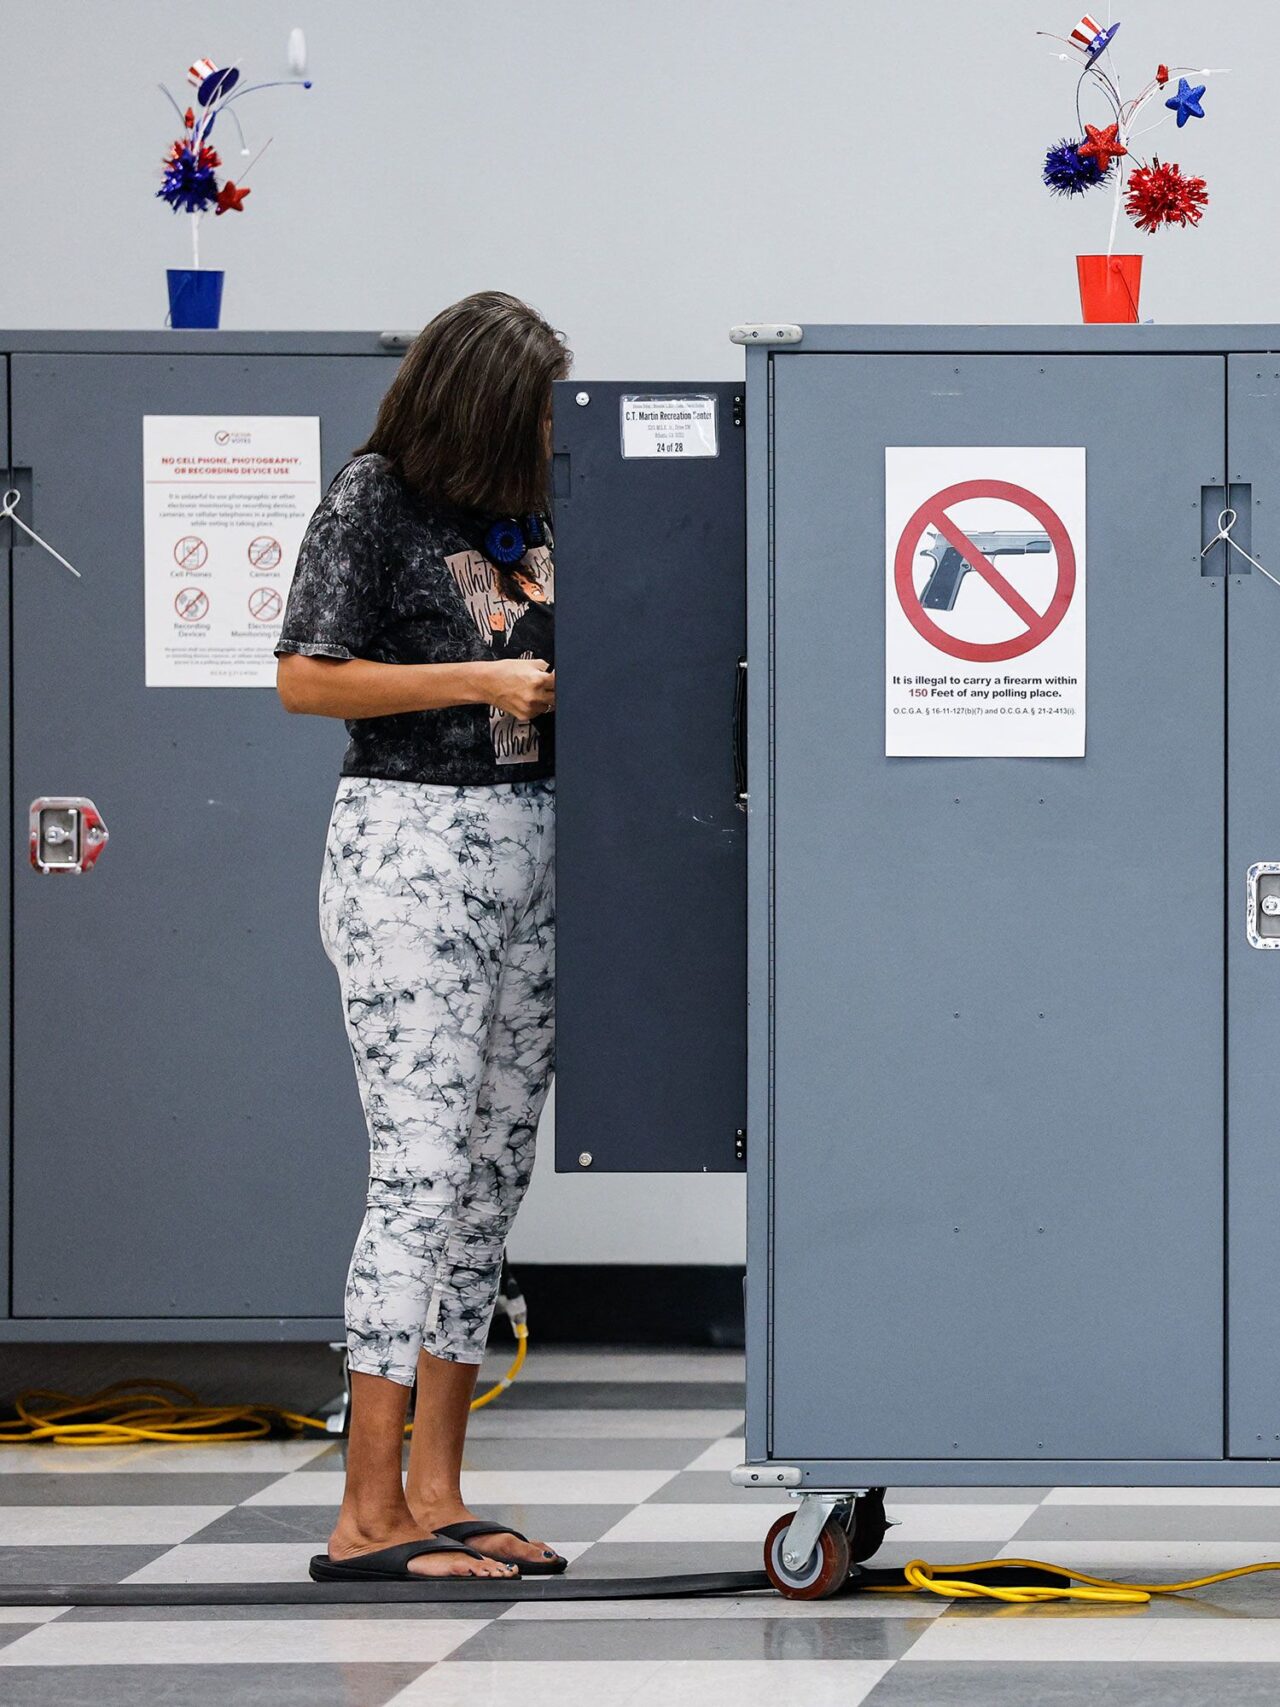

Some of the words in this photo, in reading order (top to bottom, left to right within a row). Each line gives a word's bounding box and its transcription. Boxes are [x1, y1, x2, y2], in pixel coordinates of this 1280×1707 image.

[625, 412, 637, 421] C.T.
[639, 412, 658, 420] Martin
[660, 411, 691, 420] Recreation
[657, 443, 665, 452] 24
[667, 443, 673, 452] of
[675, 443, 683, 452] 28
[893, 676, 900, 684] It
[904, 676, 912, 684] is
[915, 676, 947, 686] illegal
[963, 678, 991, 686] carry
[1004, 676, 1042, 684] firearm
[1045, 676, 1077, 684] within
[909, 689, 928, 697] 150
[931, 689, 954, 697] Feet
[957, 689, 967, 697] of
[971, 691, 989, 699] any
[992, 689, 1027, 699] polling
[1030, 689, 1061, 698] place.
